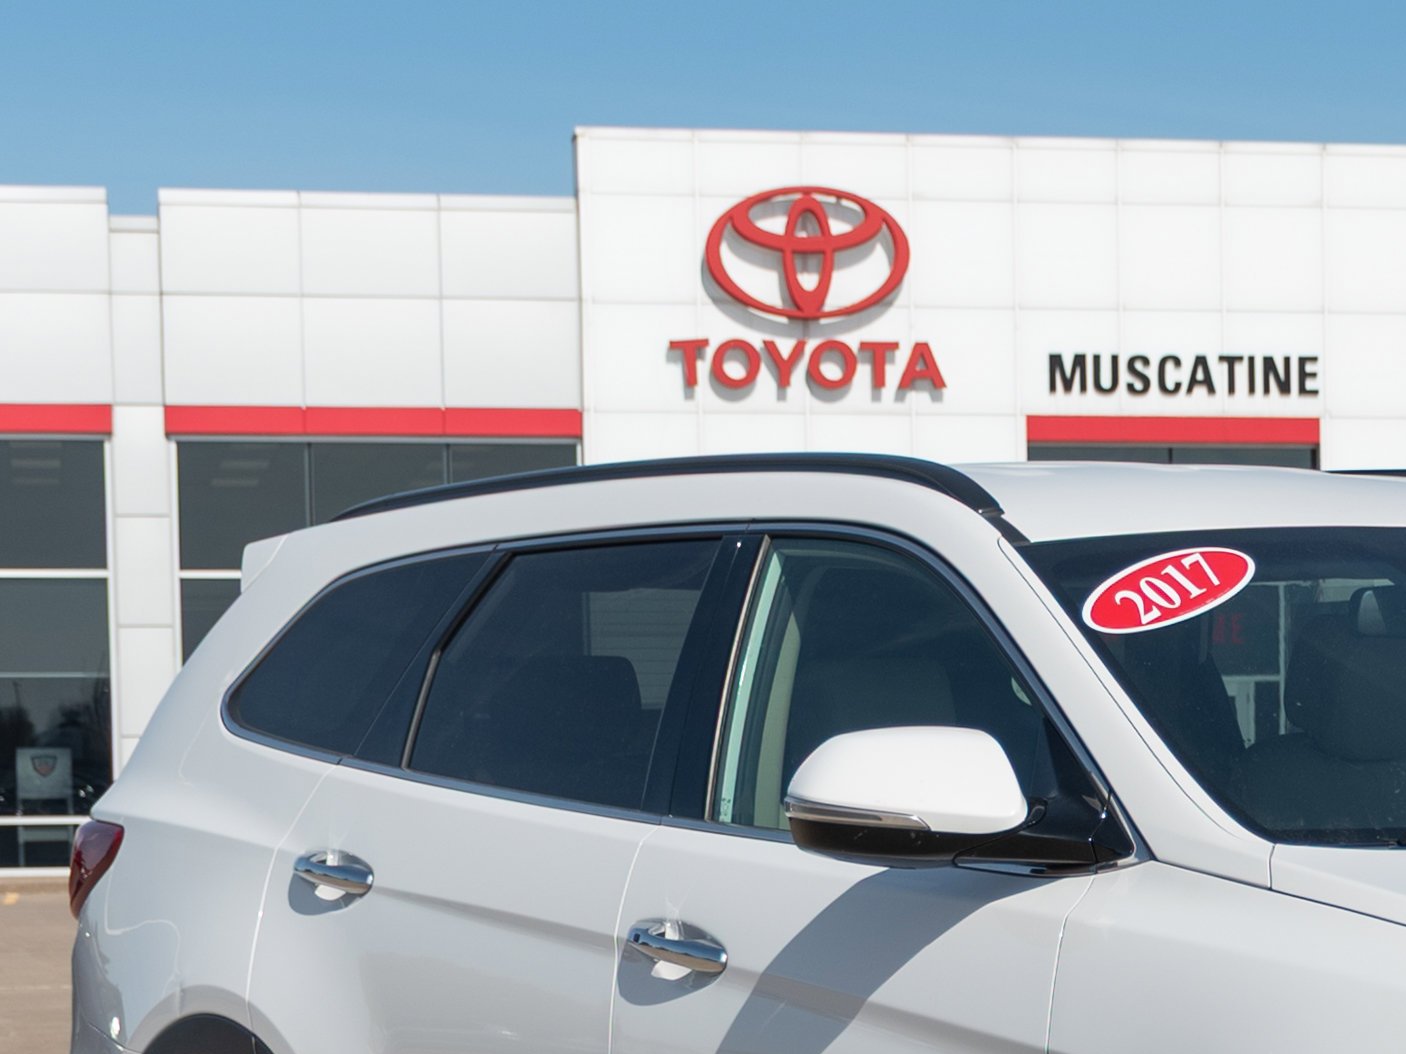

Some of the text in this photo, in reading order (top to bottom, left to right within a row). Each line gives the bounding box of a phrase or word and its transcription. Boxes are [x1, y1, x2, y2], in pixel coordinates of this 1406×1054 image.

[668, 338, 947, 391] TOYOTA
[1048, 353, 1319, 396] MUSCATINE
[1114, 552, 1221, 625] 2017
